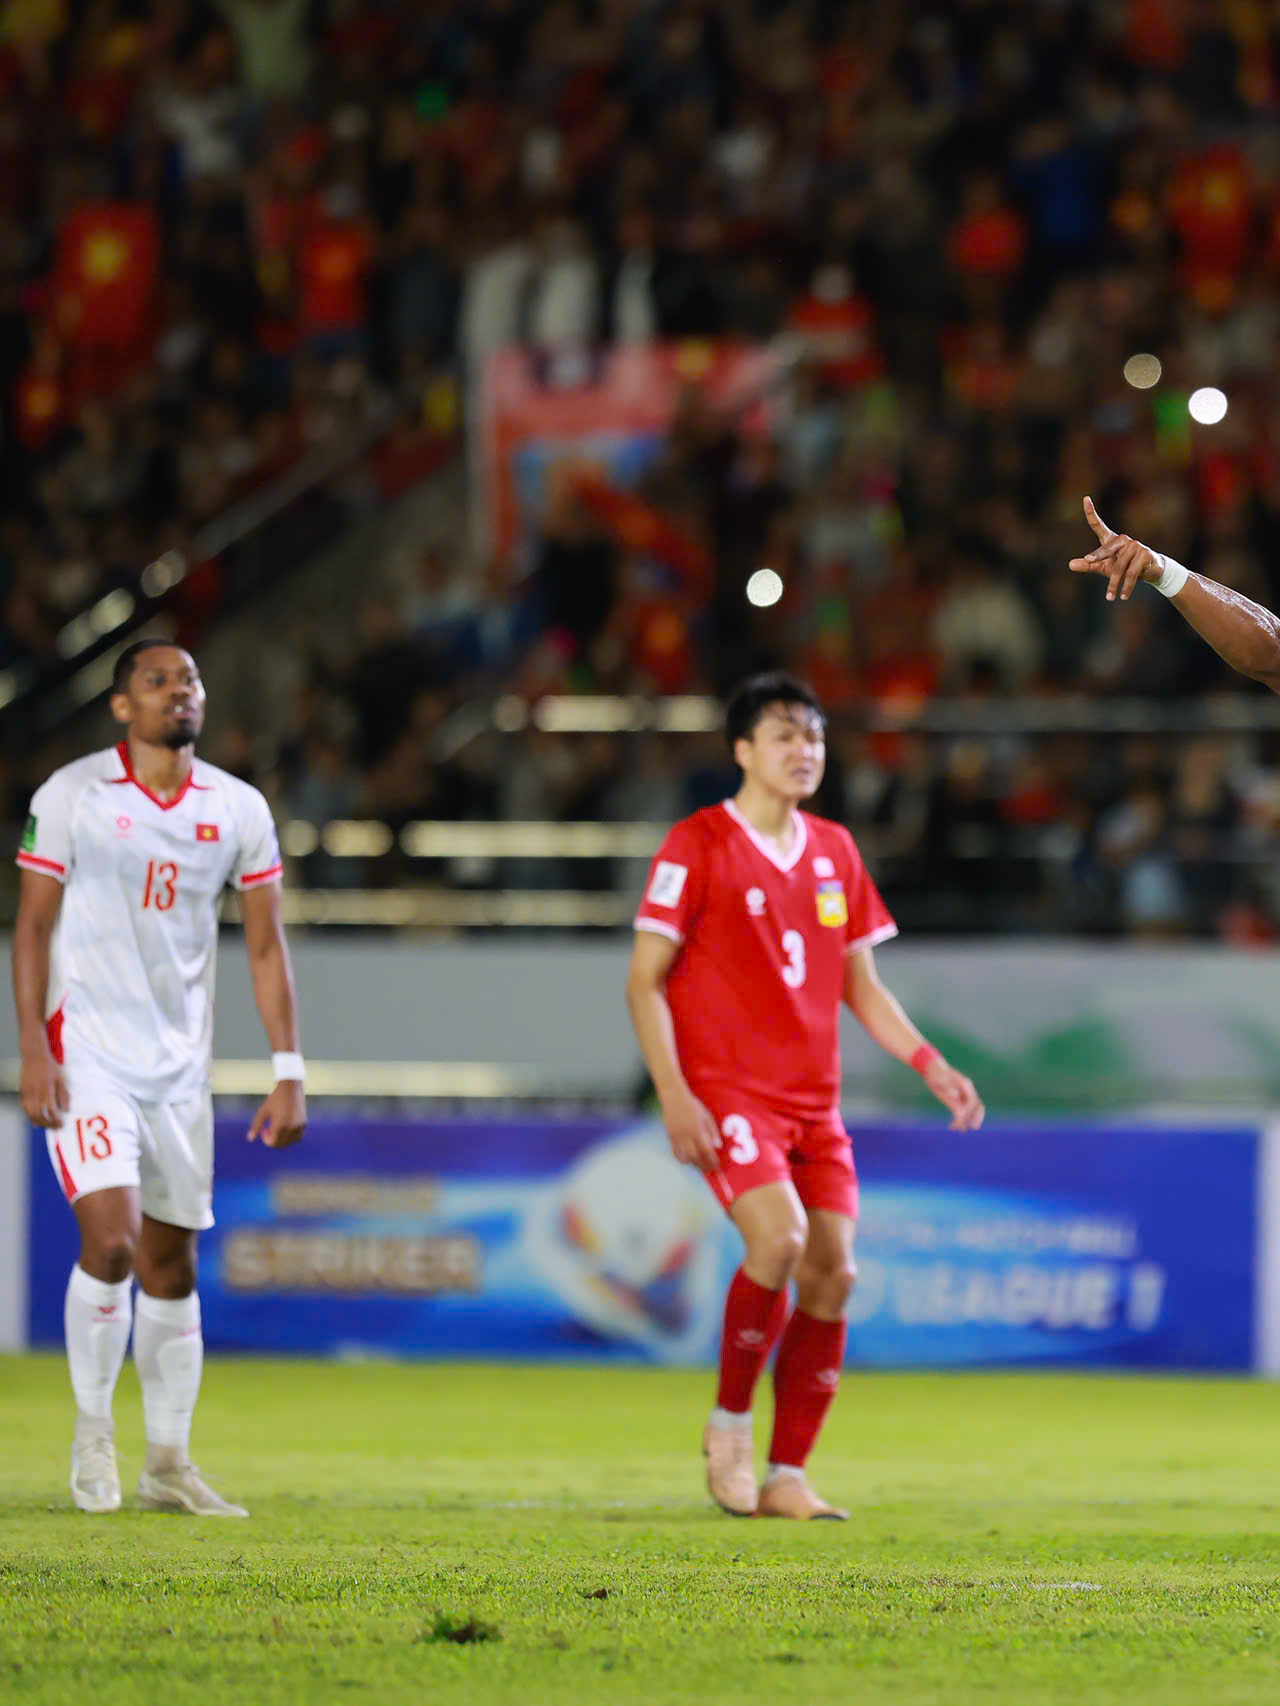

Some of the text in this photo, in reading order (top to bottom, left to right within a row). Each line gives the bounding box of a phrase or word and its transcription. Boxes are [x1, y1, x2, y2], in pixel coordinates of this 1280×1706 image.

[141, 860, 178, 911] 13
[781, 929, 806, 988] 3
[75, 1114, 113, 1164] 13
[722, 1114, 759, 1164] 3
[224, 1231, 481, 1292] STRIKER
